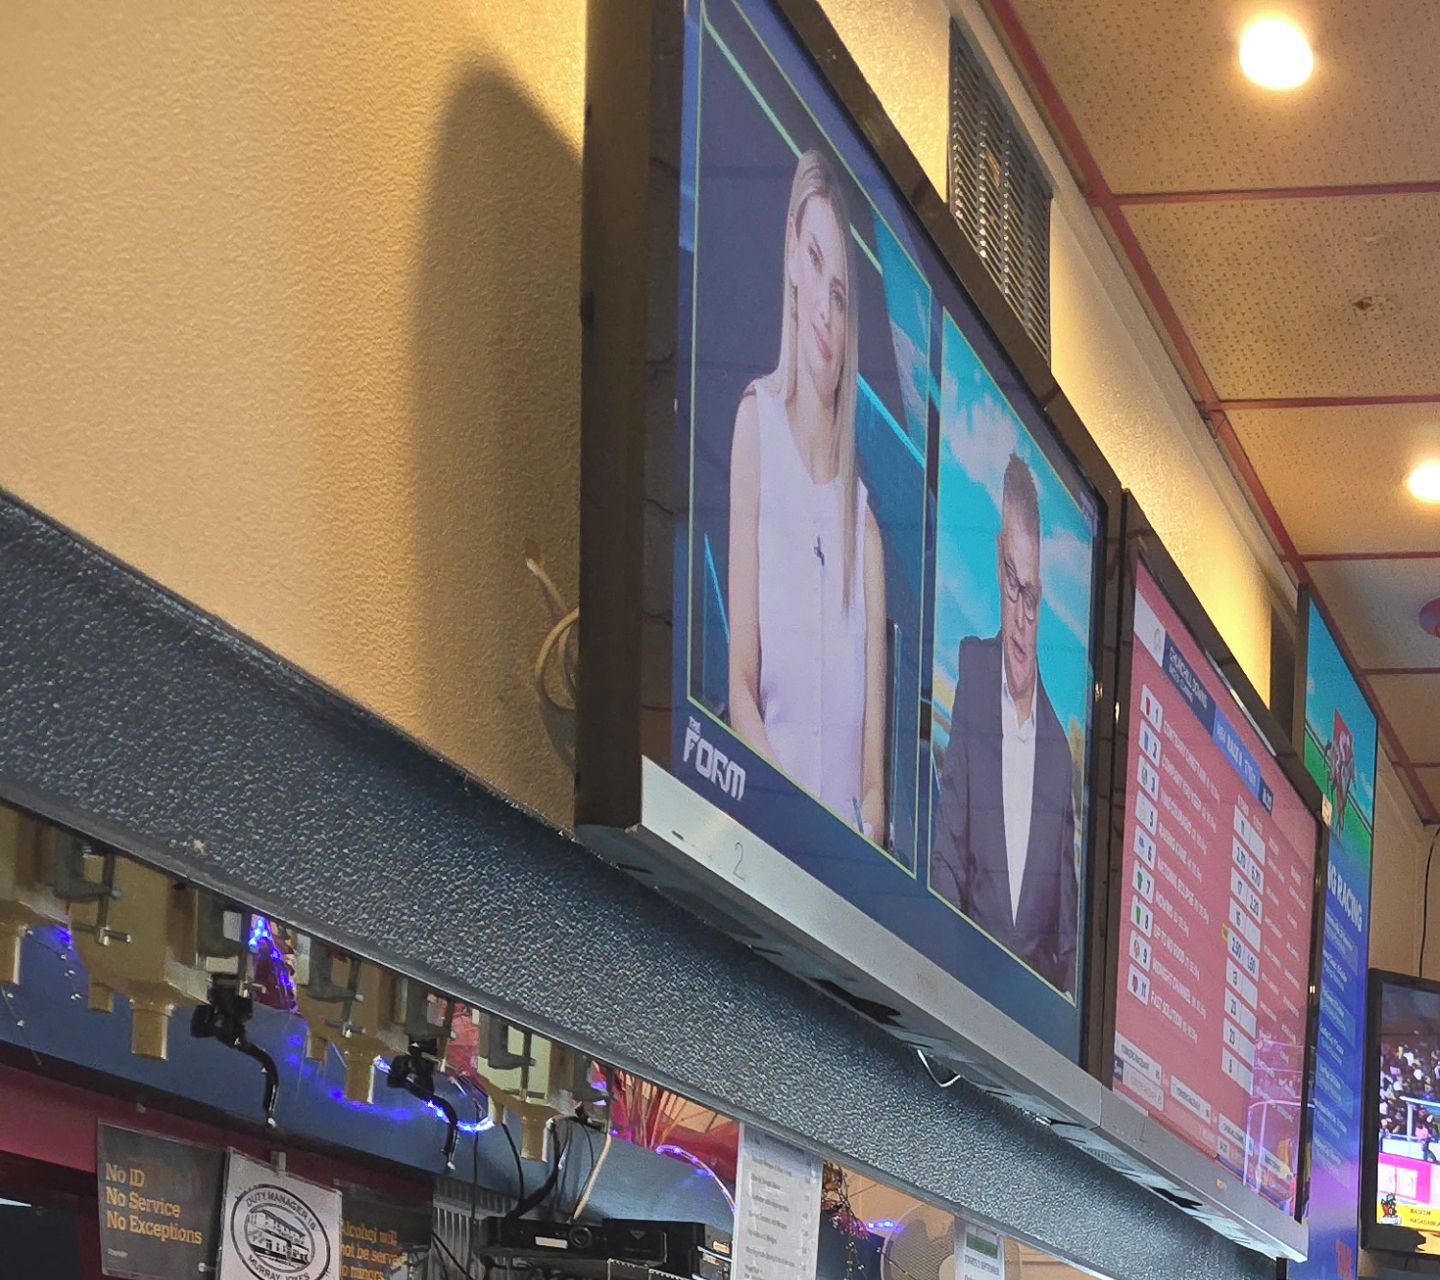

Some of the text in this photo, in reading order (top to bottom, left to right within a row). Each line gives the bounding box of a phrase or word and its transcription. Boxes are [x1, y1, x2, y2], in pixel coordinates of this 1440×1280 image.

[683, 727, 746, 800] FORM
[1153, 740, 1157, 761] 2
[732, 842, 745, 881] 2
[1146, 876, 1150, 898] 7
[1336, 873, 1362, 933] RACING
[106, 1162, 145, 1188] No ID
[106, 1187, 181, 1218] No Service
[267, 1191, 308, 1220] MANAGER
[106, 1210, 203, 1245] No Exceptions
[380, 1229, 397, 1246] will
